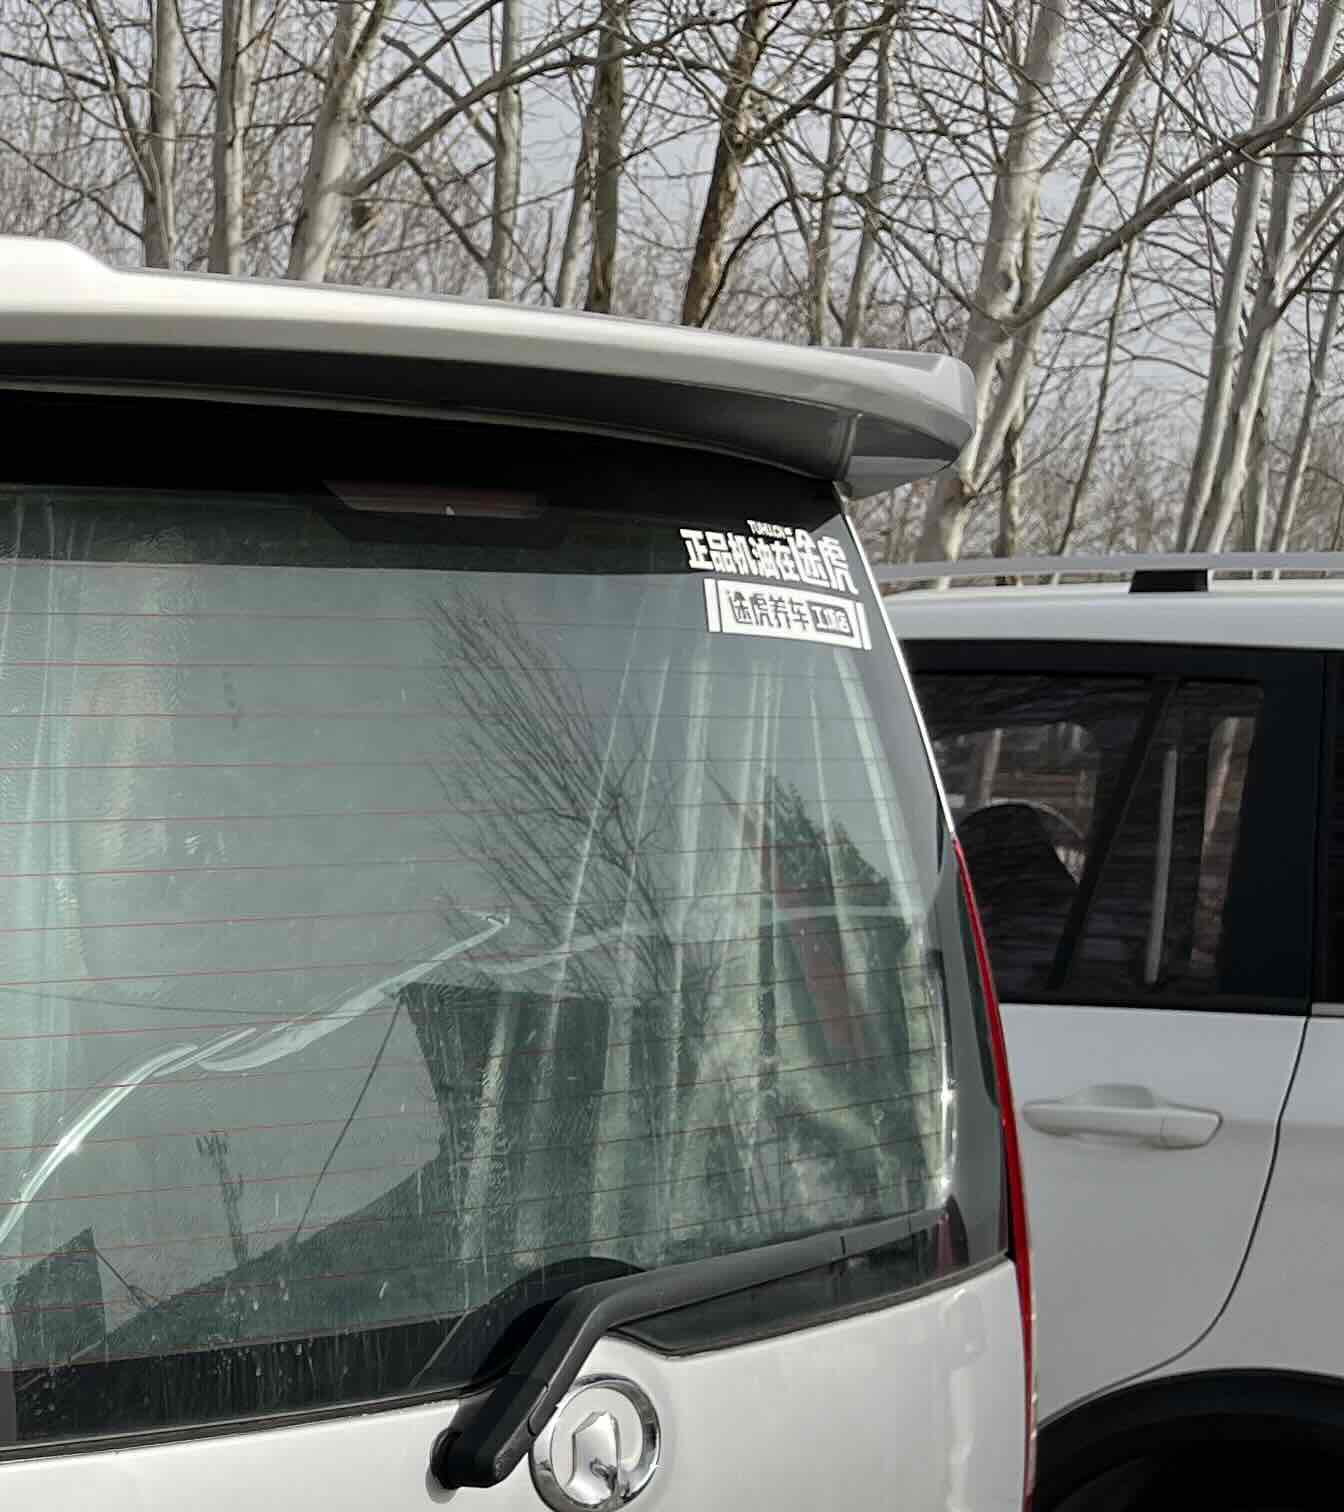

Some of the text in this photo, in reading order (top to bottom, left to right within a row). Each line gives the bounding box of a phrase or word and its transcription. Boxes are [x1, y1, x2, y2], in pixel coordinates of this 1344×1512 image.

[679, 527, 860, 596] 正品机油在途虎
